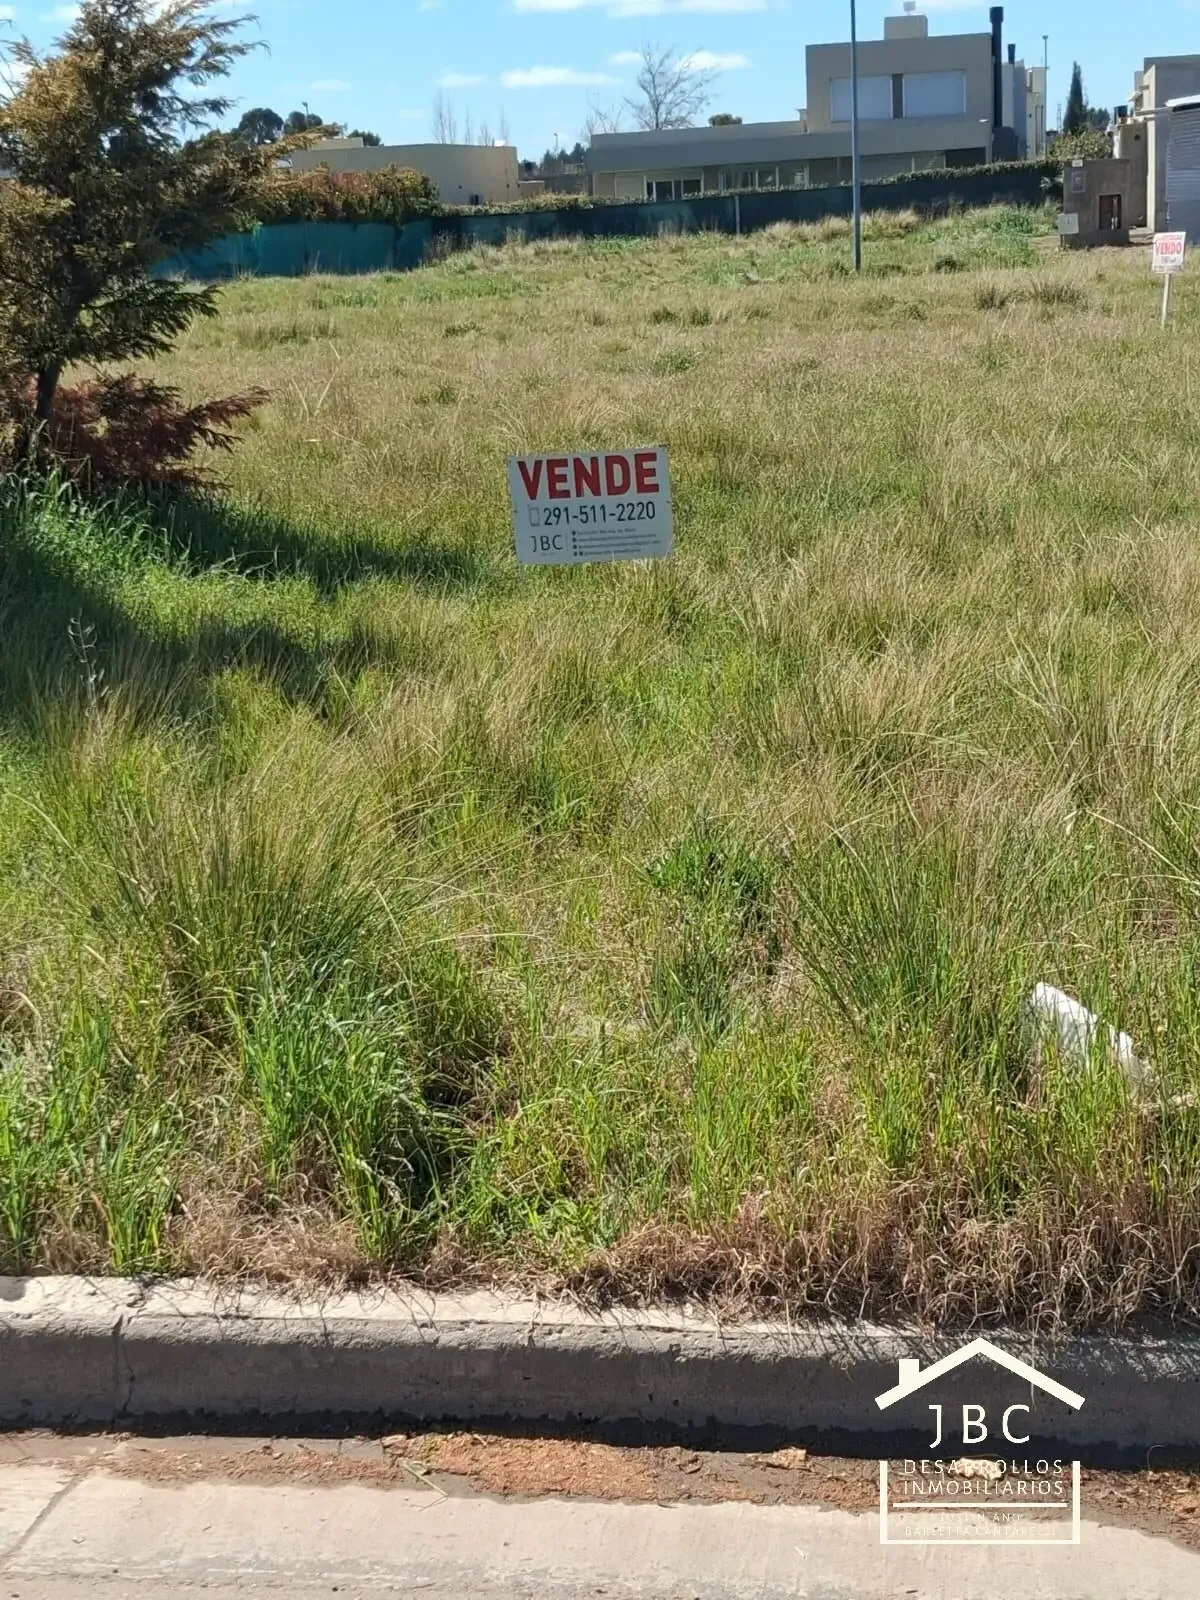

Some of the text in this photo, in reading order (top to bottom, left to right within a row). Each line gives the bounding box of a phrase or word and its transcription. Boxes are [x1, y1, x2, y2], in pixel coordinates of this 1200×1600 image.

[1155, 241, 1182, 256] VENDO
[517, 452, 660, 501] VENDE
[544, 500, 656, 527] 291-511-2220
[530, 534, 564, 553] JBC
